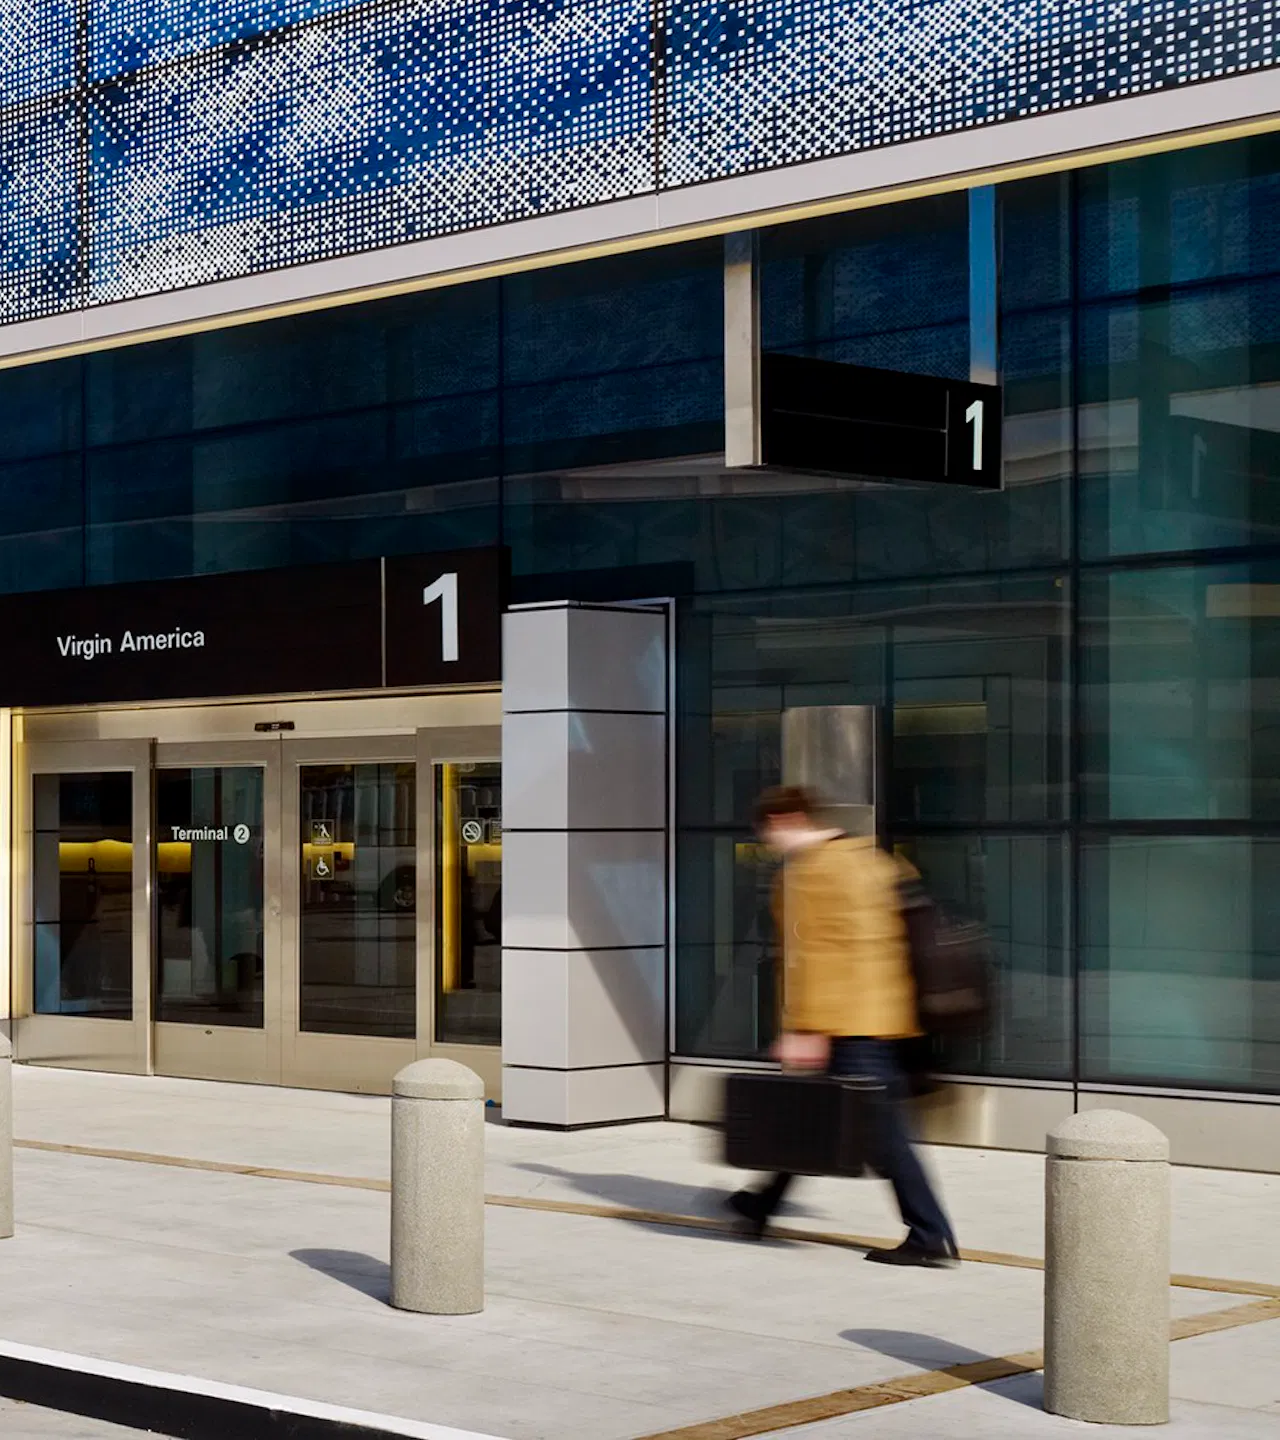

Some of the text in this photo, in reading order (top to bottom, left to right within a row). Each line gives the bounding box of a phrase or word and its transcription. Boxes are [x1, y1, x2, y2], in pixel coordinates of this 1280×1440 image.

[965, 399, 984, 471] 1
[423, 572, 459, 662] 1
[57, 627, 205, 660] Virgin America
[171, 825, 228, 841] Terminal
